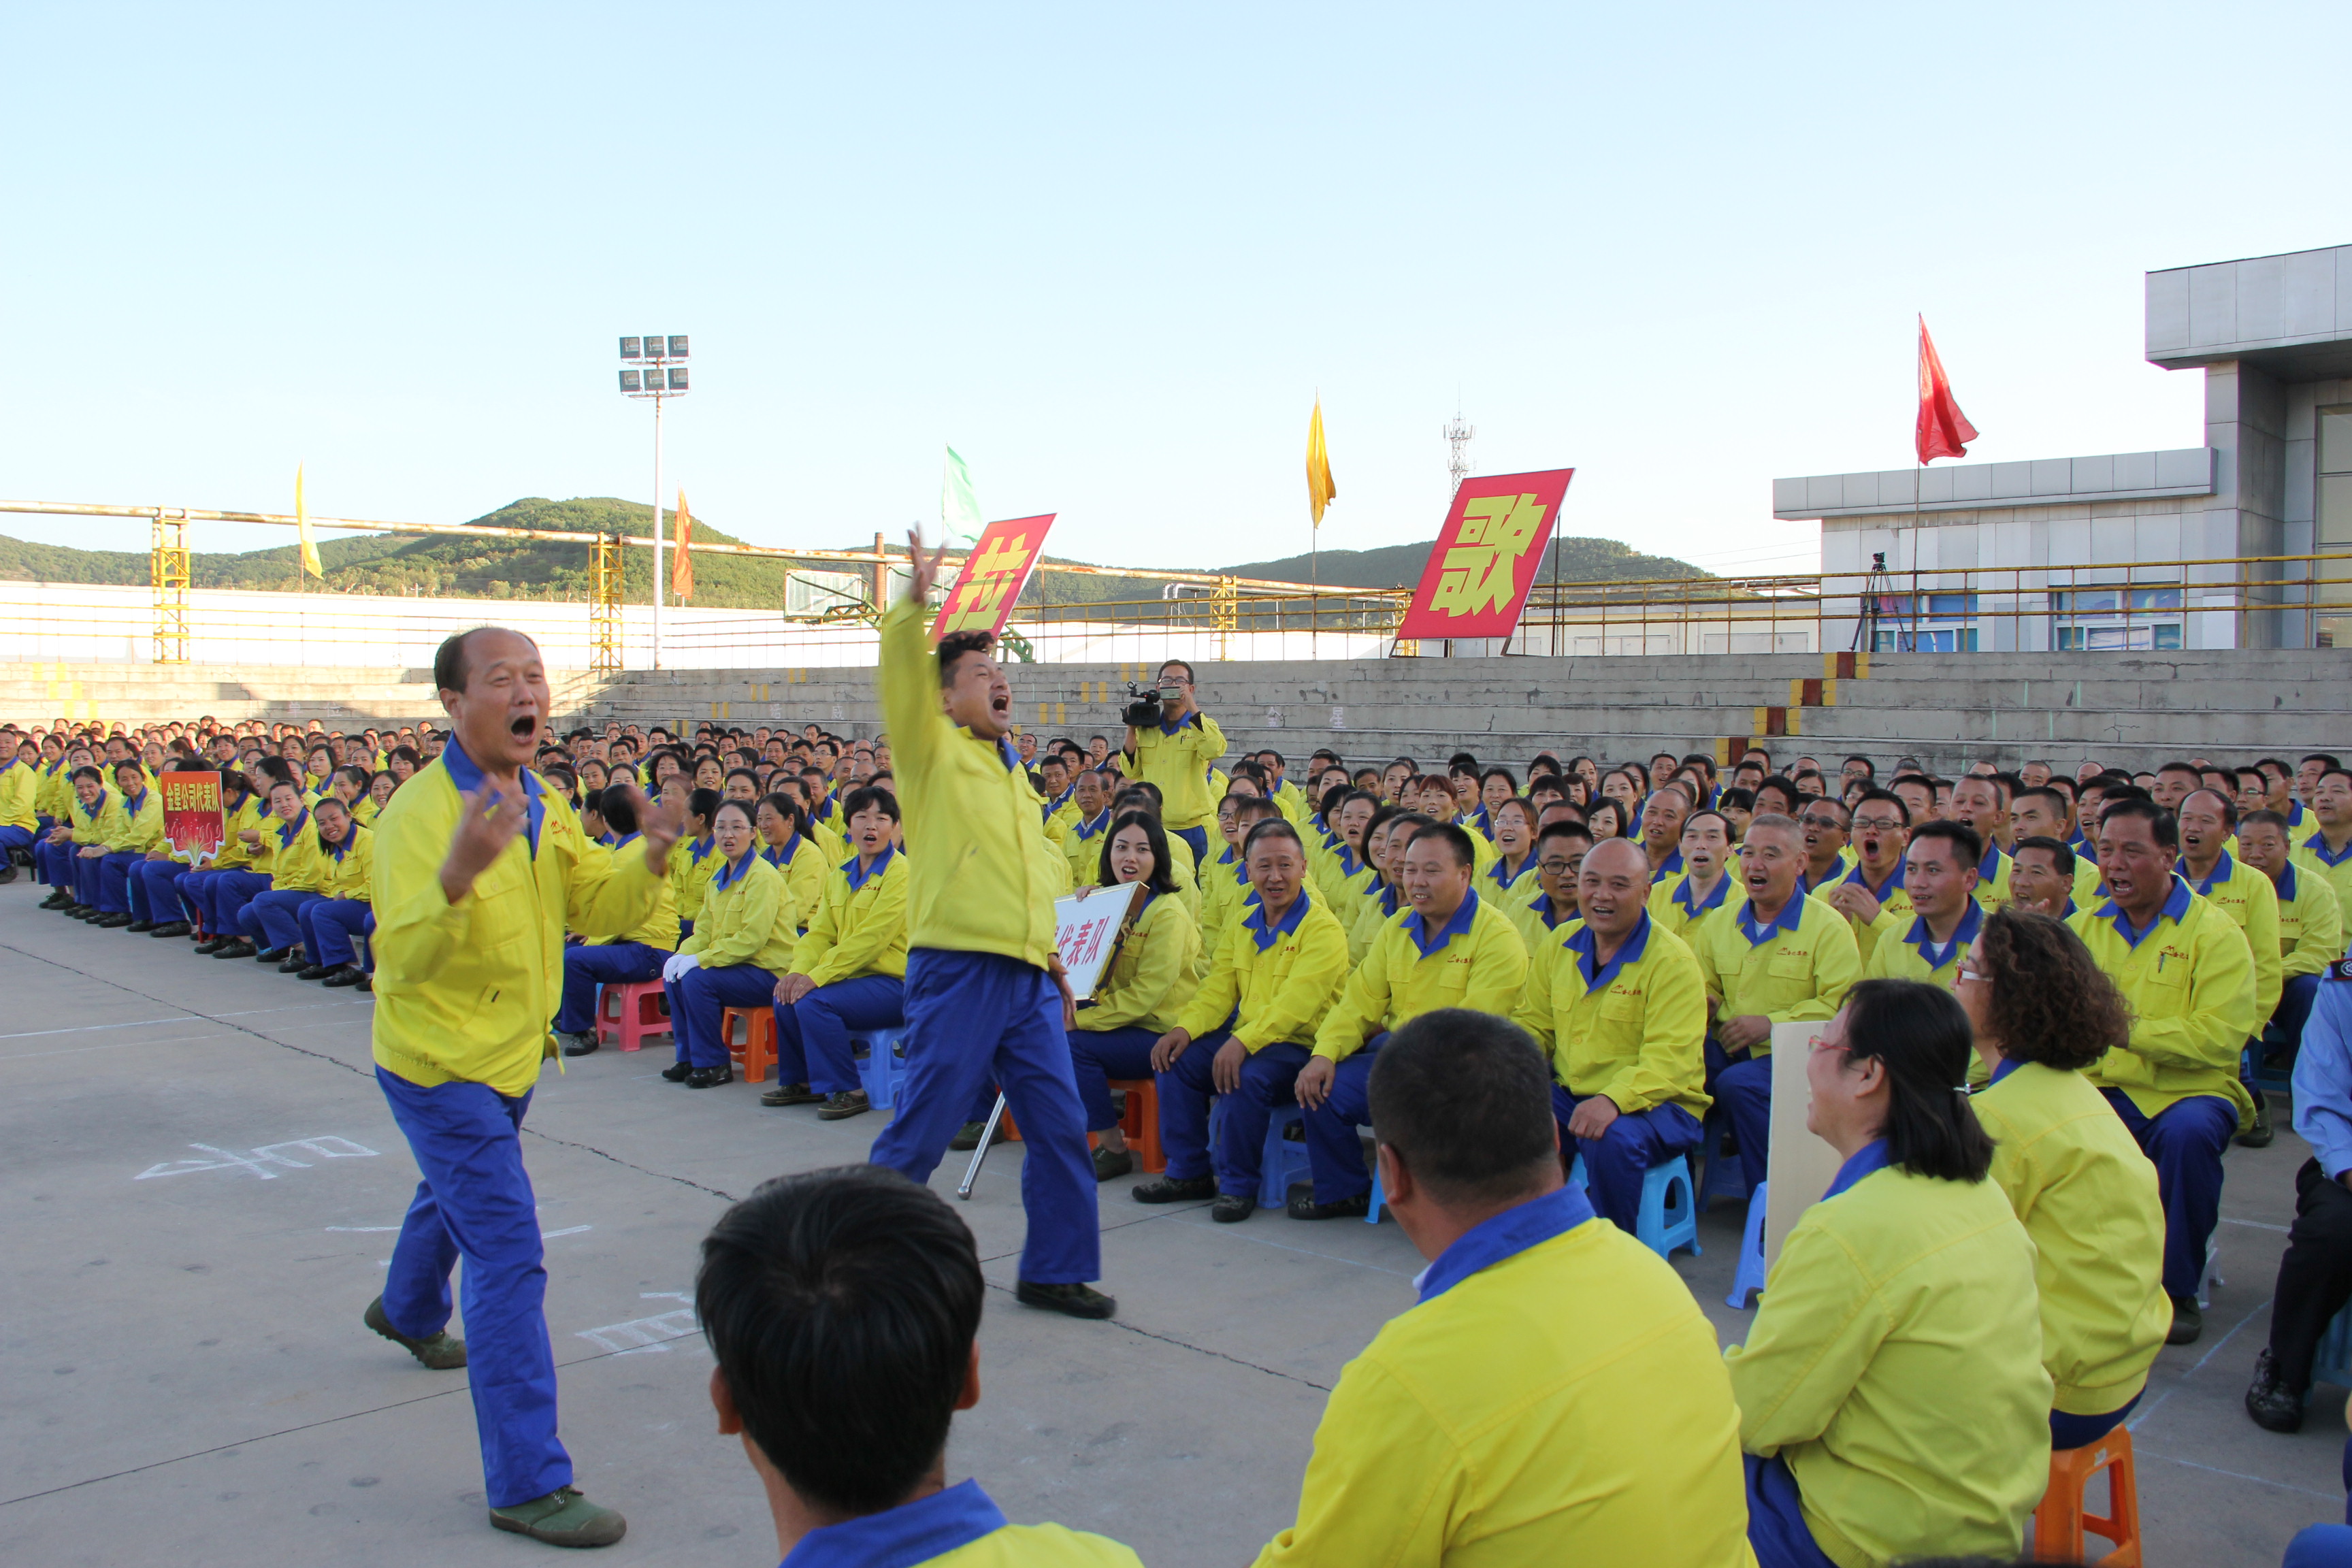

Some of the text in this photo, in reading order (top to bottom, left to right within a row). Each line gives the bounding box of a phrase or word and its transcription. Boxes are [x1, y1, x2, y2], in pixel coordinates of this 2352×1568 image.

[943, 533, 1030, 633] 拉
[1428, 493, 1548, 617] 歌
[166, 781, 220, 812] 金星公司代表队
